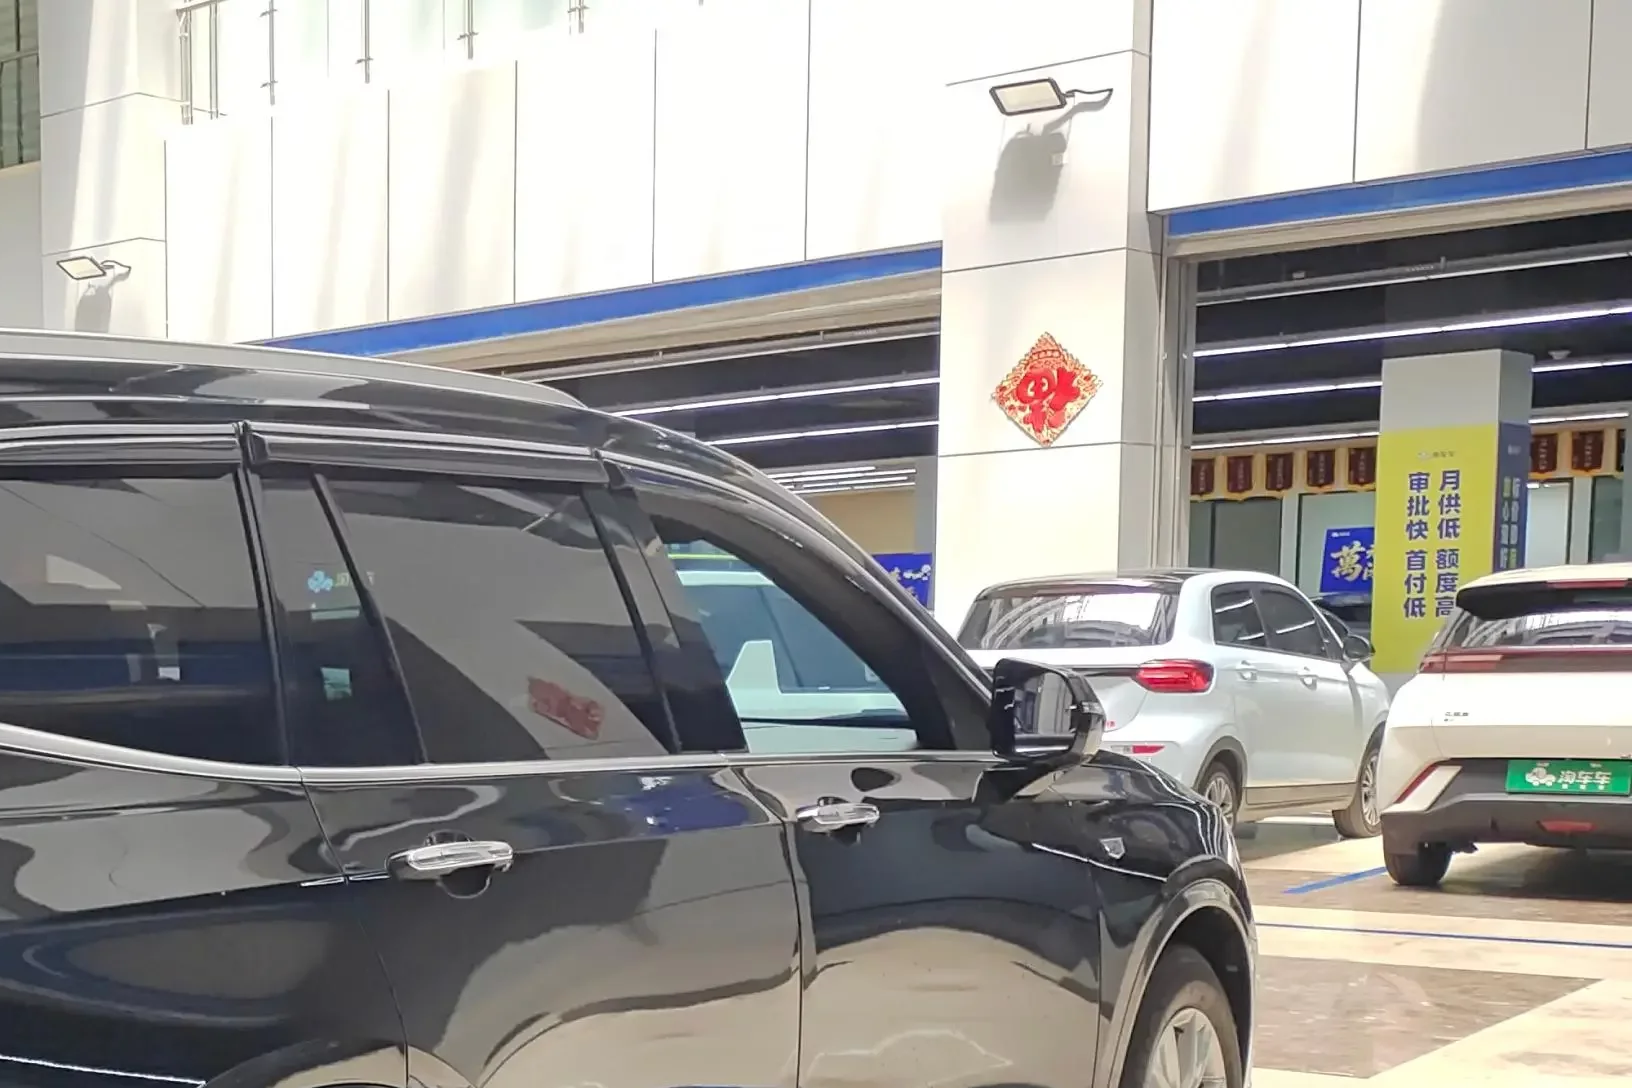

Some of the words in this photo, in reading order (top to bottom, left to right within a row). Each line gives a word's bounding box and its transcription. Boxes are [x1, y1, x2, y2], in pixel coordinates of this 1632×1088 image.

[1405, 471, 1430, 541] 审批快
[1437, 470, 1461, 539] 月供低
[1403, 549, 1428, 618] 首付低
[1435, 548, 1459, 618] 额度高
